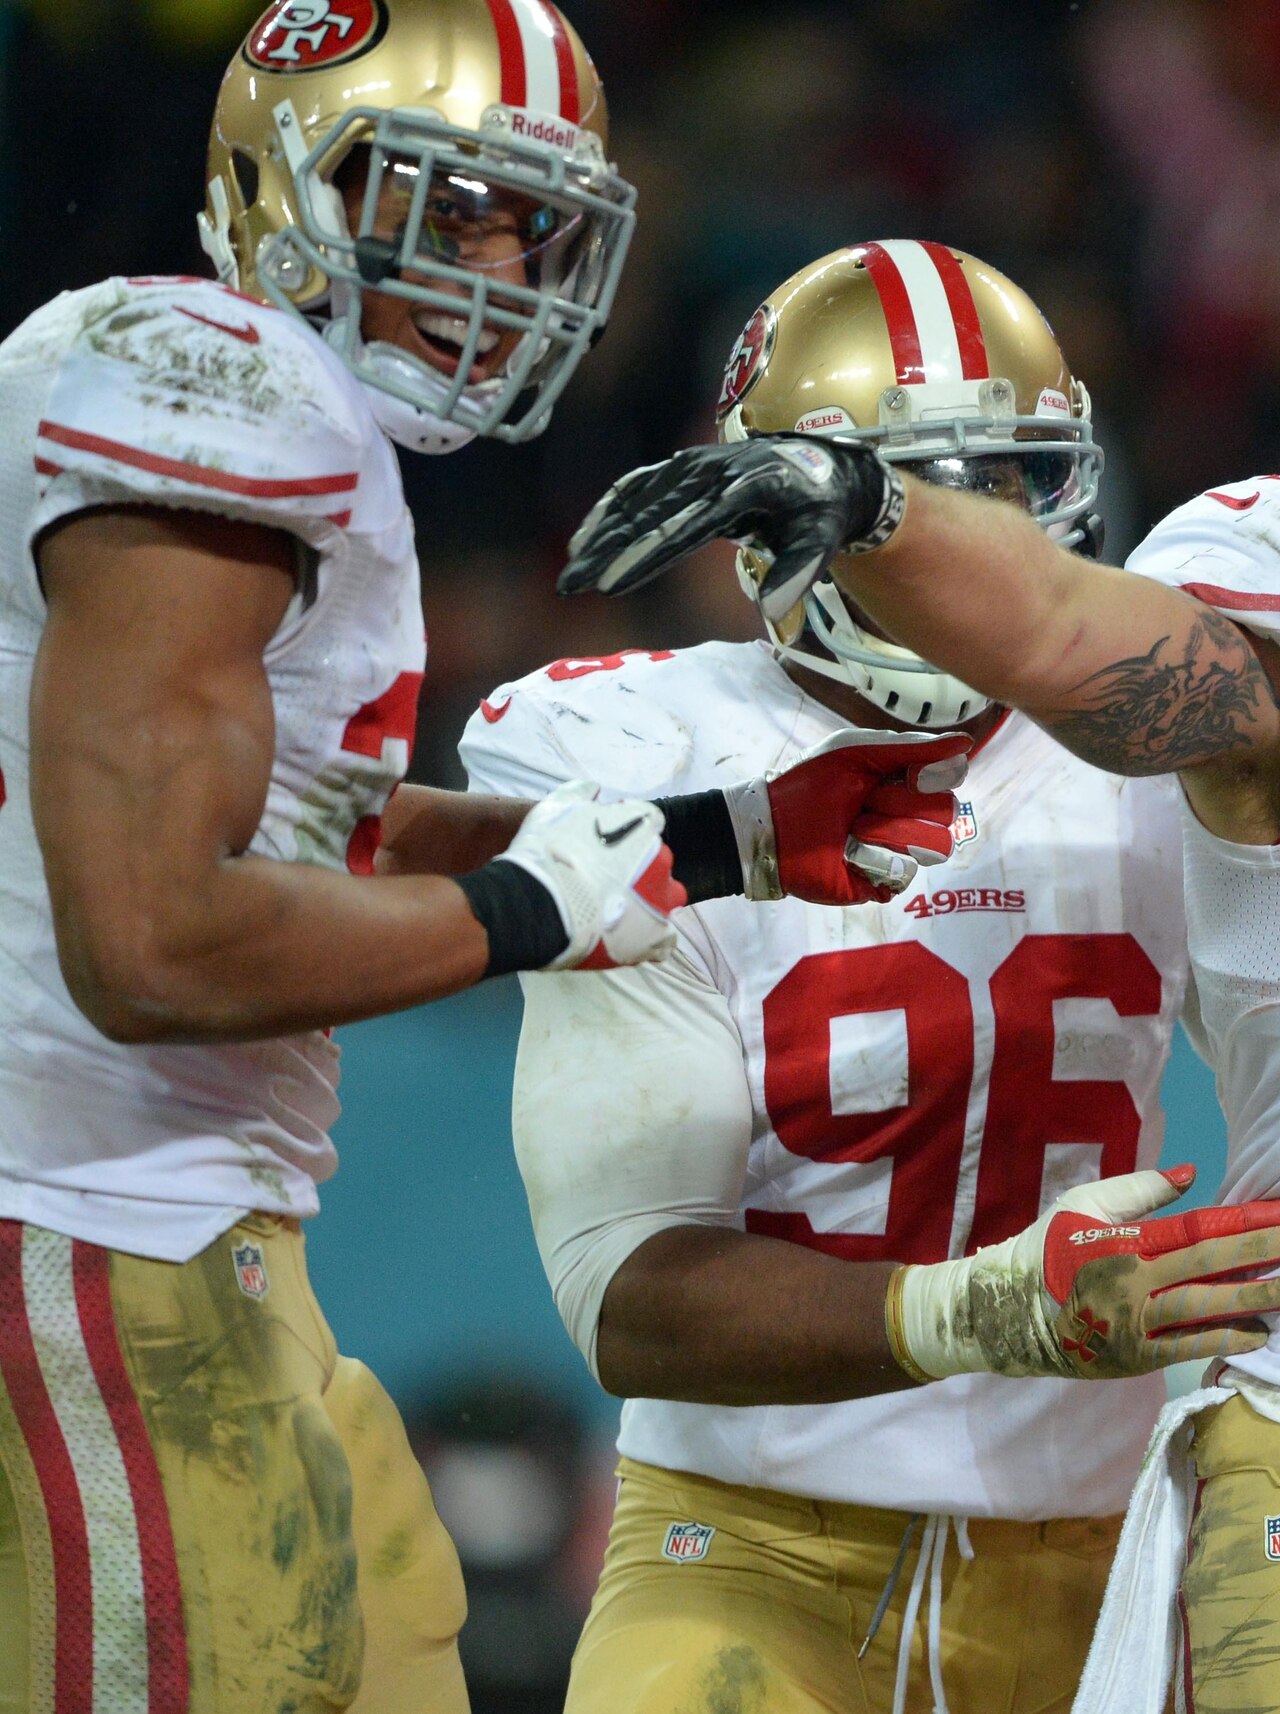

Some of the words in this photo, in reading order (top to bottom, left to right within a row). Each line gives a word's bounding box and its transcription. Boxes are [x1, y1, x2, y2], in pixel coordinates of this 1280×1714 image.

[511, 112, 576, 150] Riddell
[796, 412, 843, 433] 49ERS
[903, 887, 1026, 919] 49ERS
[745, 933, 1162, 1264] 96
[1068, 1226, 1141, 1246] 49ERS
[669, 1536, 701, 1556] NFL
